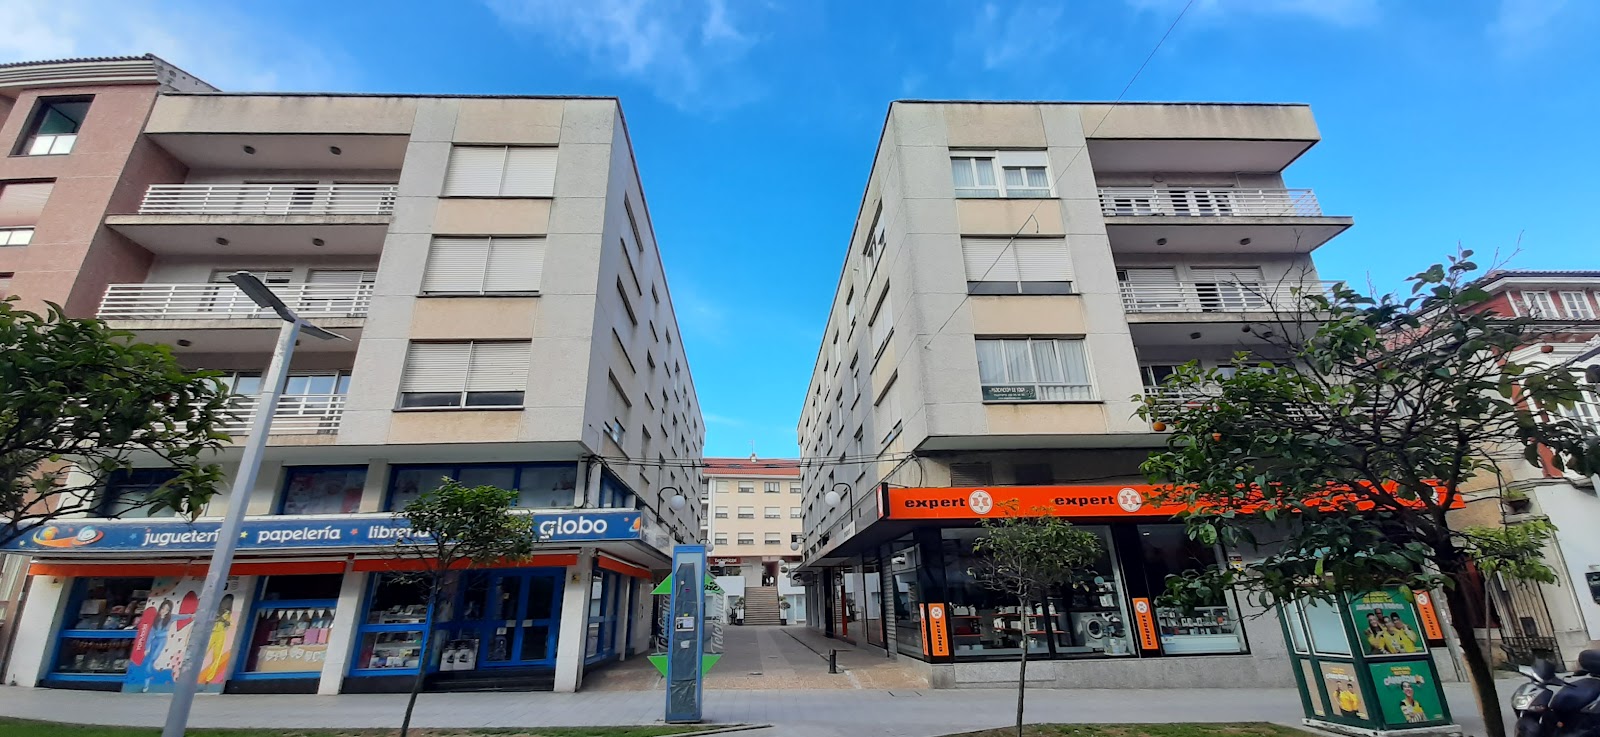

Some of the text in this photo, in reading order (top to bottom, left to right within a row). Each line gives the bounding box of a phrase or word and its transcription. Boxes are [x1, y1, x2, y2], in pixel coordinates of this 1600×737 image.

[904, 497, 965, 509] expert
[1054, 496, 1115, 507] expert
[142, 528, 222, 546] jugueterí
[257, 525, 341, 543] papelería
[540, 516, 608, 539] globo
[935, 620, 943, 652] expert
[1141, 614, 1152, 646] expert
